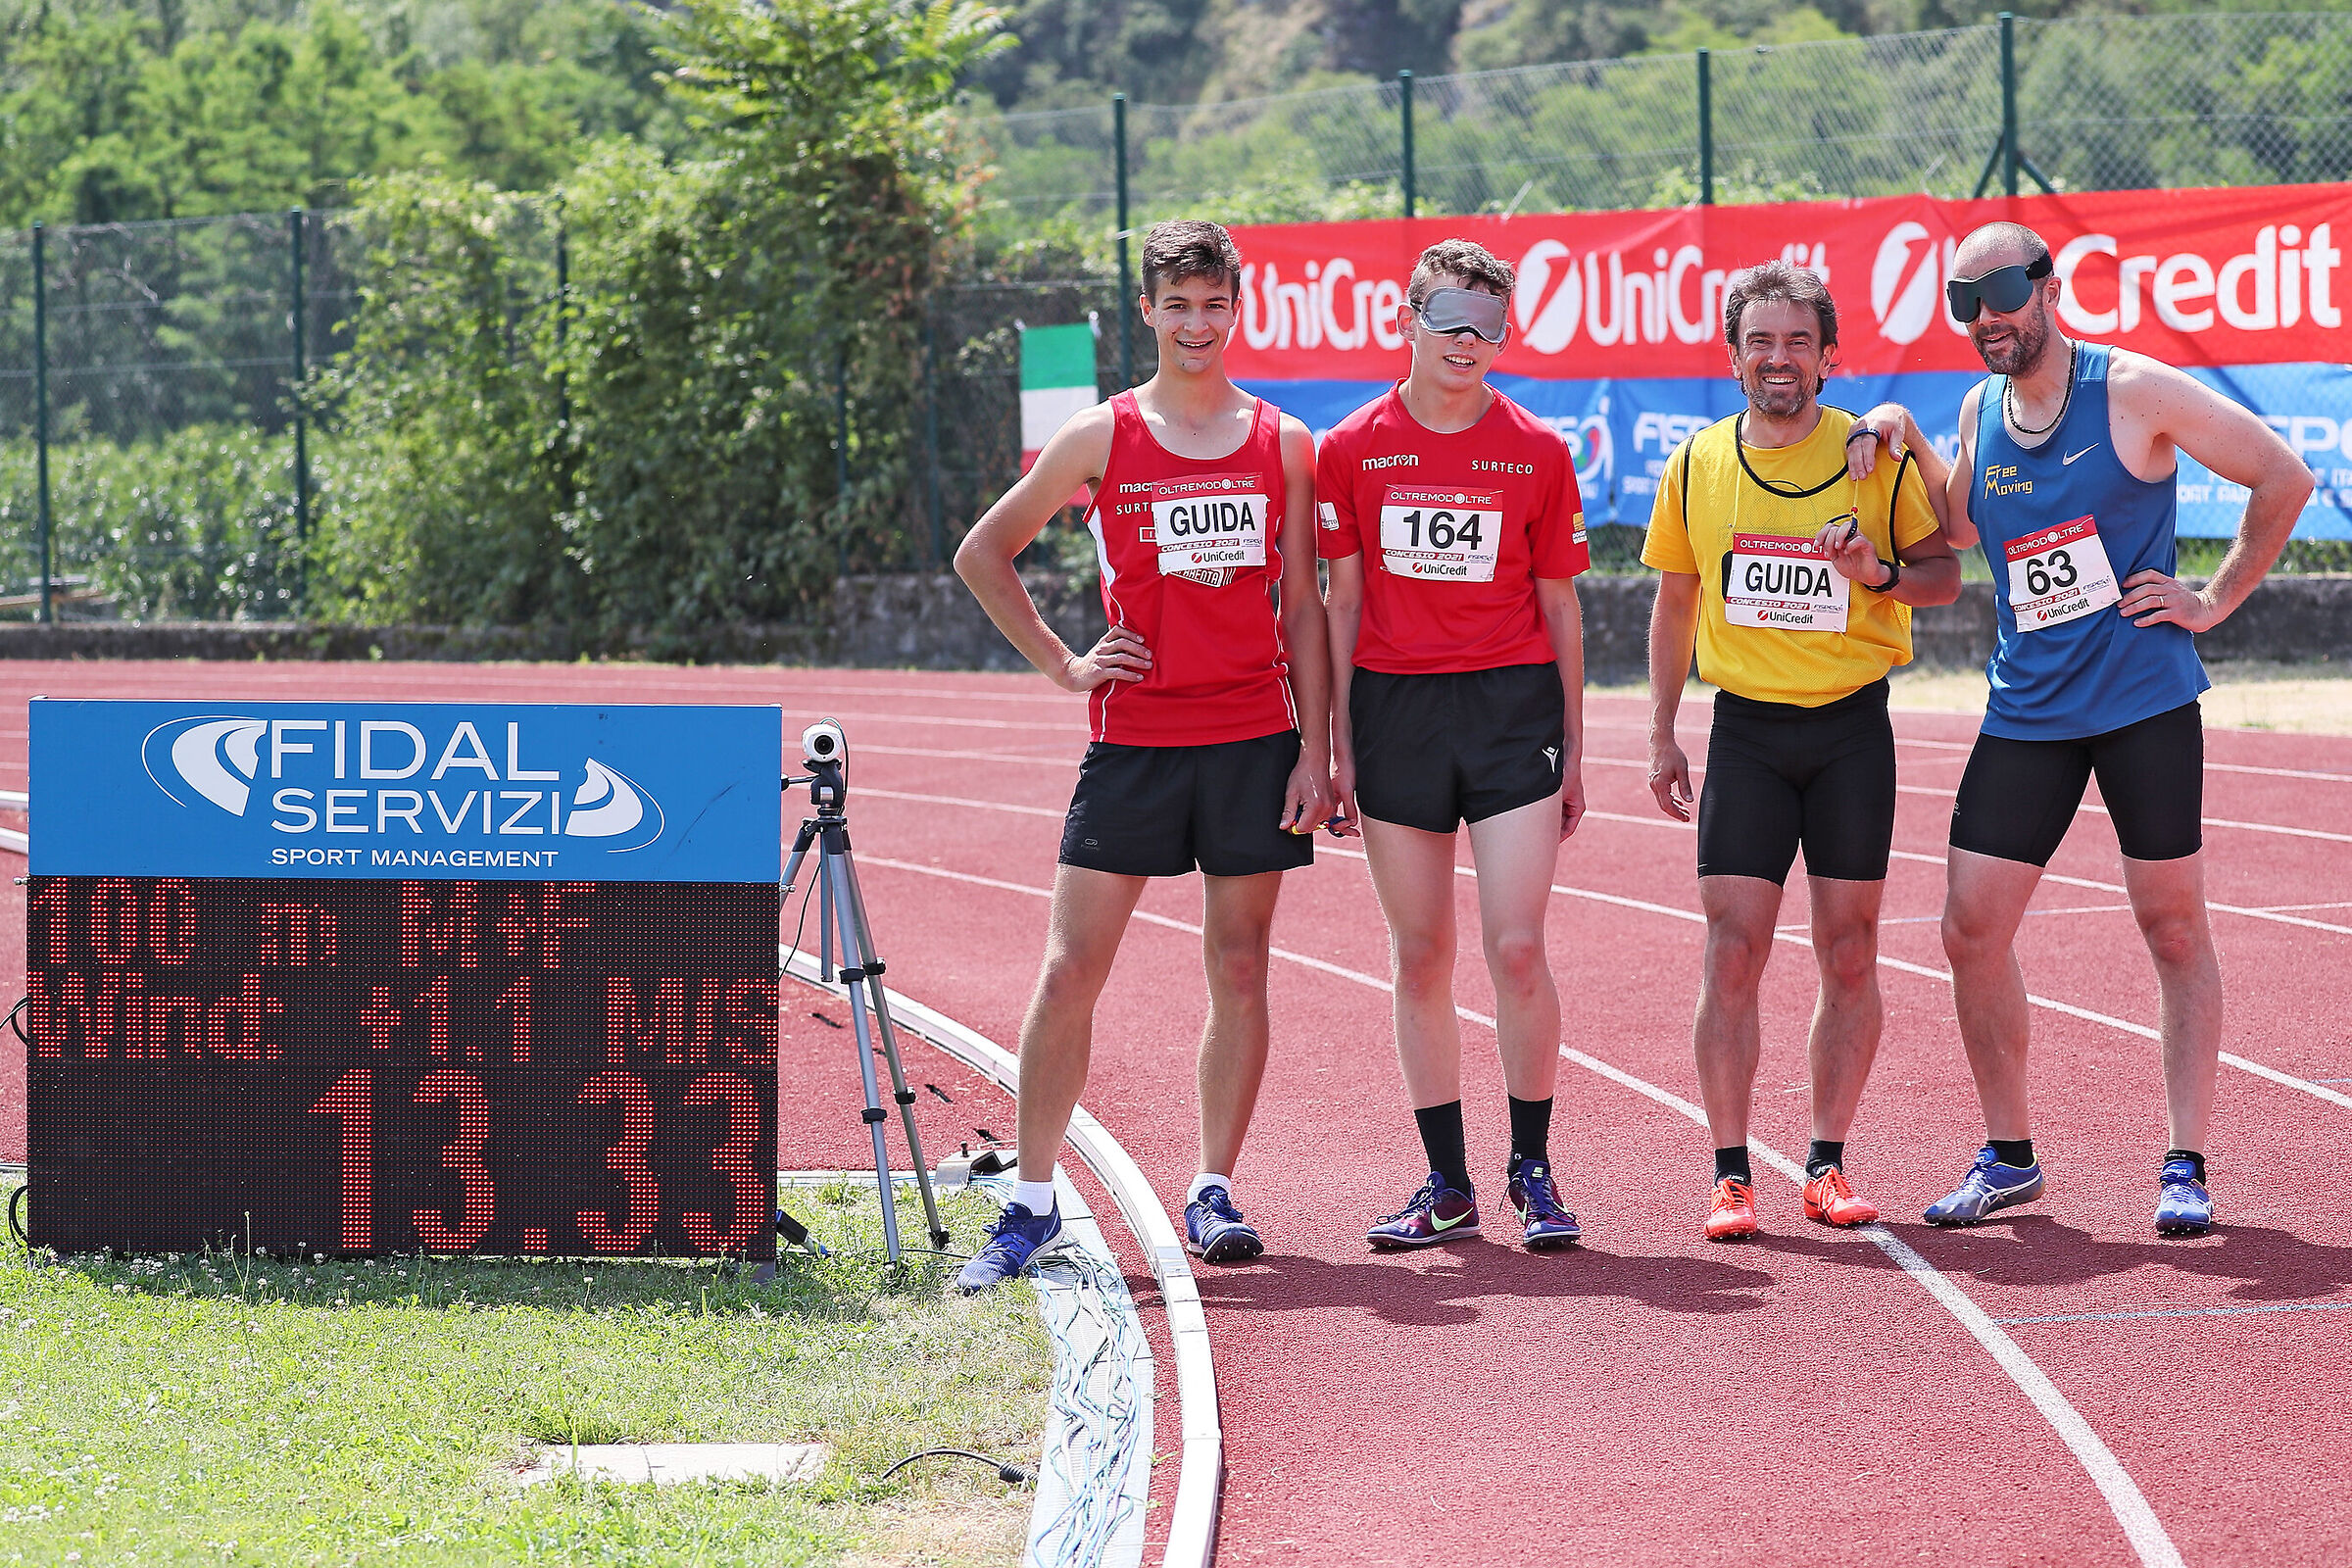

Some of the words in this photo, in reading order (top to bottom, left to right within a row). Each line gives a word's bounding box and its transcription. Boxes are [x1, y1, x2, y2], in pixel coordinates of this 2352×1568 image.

[1942, 221, 2342, 336] Credit
[1241, 257, 1405, 351] UniCre
[1362, 454, 1419, 470] macron
[1471, 460, 1534, 475] SURTECO
[1984, 465, 2018, 482] Free
[1119, 481, 1152, 494] macr
[1984, 479, 2034, 500] Moving
[1115, 502, 1150, 515] SURT
[1169, 501, 1255, 537] GUIDA
[1403, 510, 1483, 551] 164
[1214, 539, 1239, 548] 2021
[1740, 539, 1823, 554] OLTREMODOLT
[1203, 550, 1245, 563] UniCredit
[1385, 549, 1436, 560] CONCESIO
[1437, 553, 1464, 562] 2021
[1424, 564, 1467, 576] UniCredit
[1744, 562, 1833, 598] GUIDA
[2026, 550, 2078, 596] 63
[1730, 597, 1782, 608] CONCESIO
[1782, 602, 1808, 611] 2021
[2054, 588, 2080, 602] 2021
[1770, 612, 1813, 624] UniCredit
[2047, 598, 2089, 619] UniCredit
[270, 720, 561, 782] FIDAL
[270, 787, 562, 836] SERVIZI
[271, 848, 363, 867] SPORT
[370, 849, 560, 868] MANAGEMENT
[29, 877, 197, 965] 100
[260, 903, 338, 967] m
[400, 879, 596, 969] M+F
[27, 971, 285, 1059] Wind:
[360, 974, 532, 1063] +1.1
[606, 977, 779, 1065] M/S
[307, 1068, 767, 1252] 13.33
